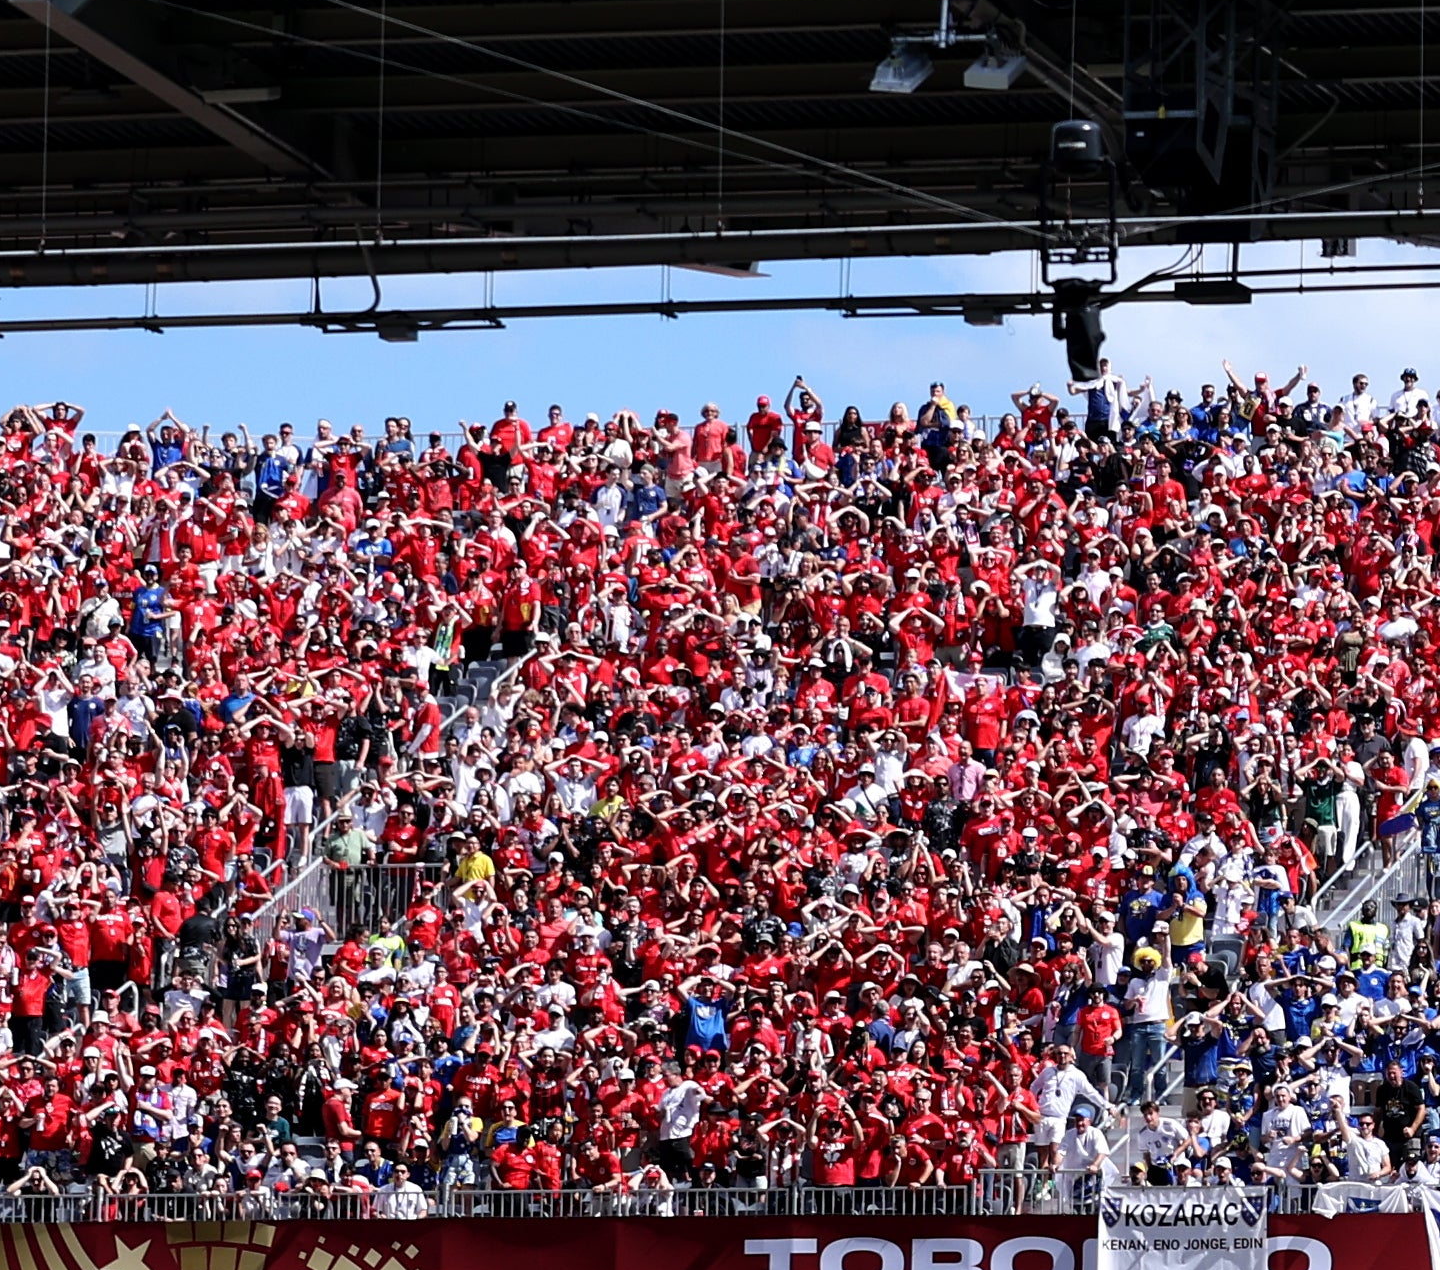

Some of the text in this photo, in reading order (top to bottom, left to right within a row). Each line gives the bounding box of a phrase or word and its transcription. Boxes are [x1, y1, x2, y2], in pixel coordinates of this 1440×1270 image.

[1124, 1202, 1239, 1227] KOZARAC
[1102, 1236, 1263, 1252] KENAN, ENO JONGE, EDIN
